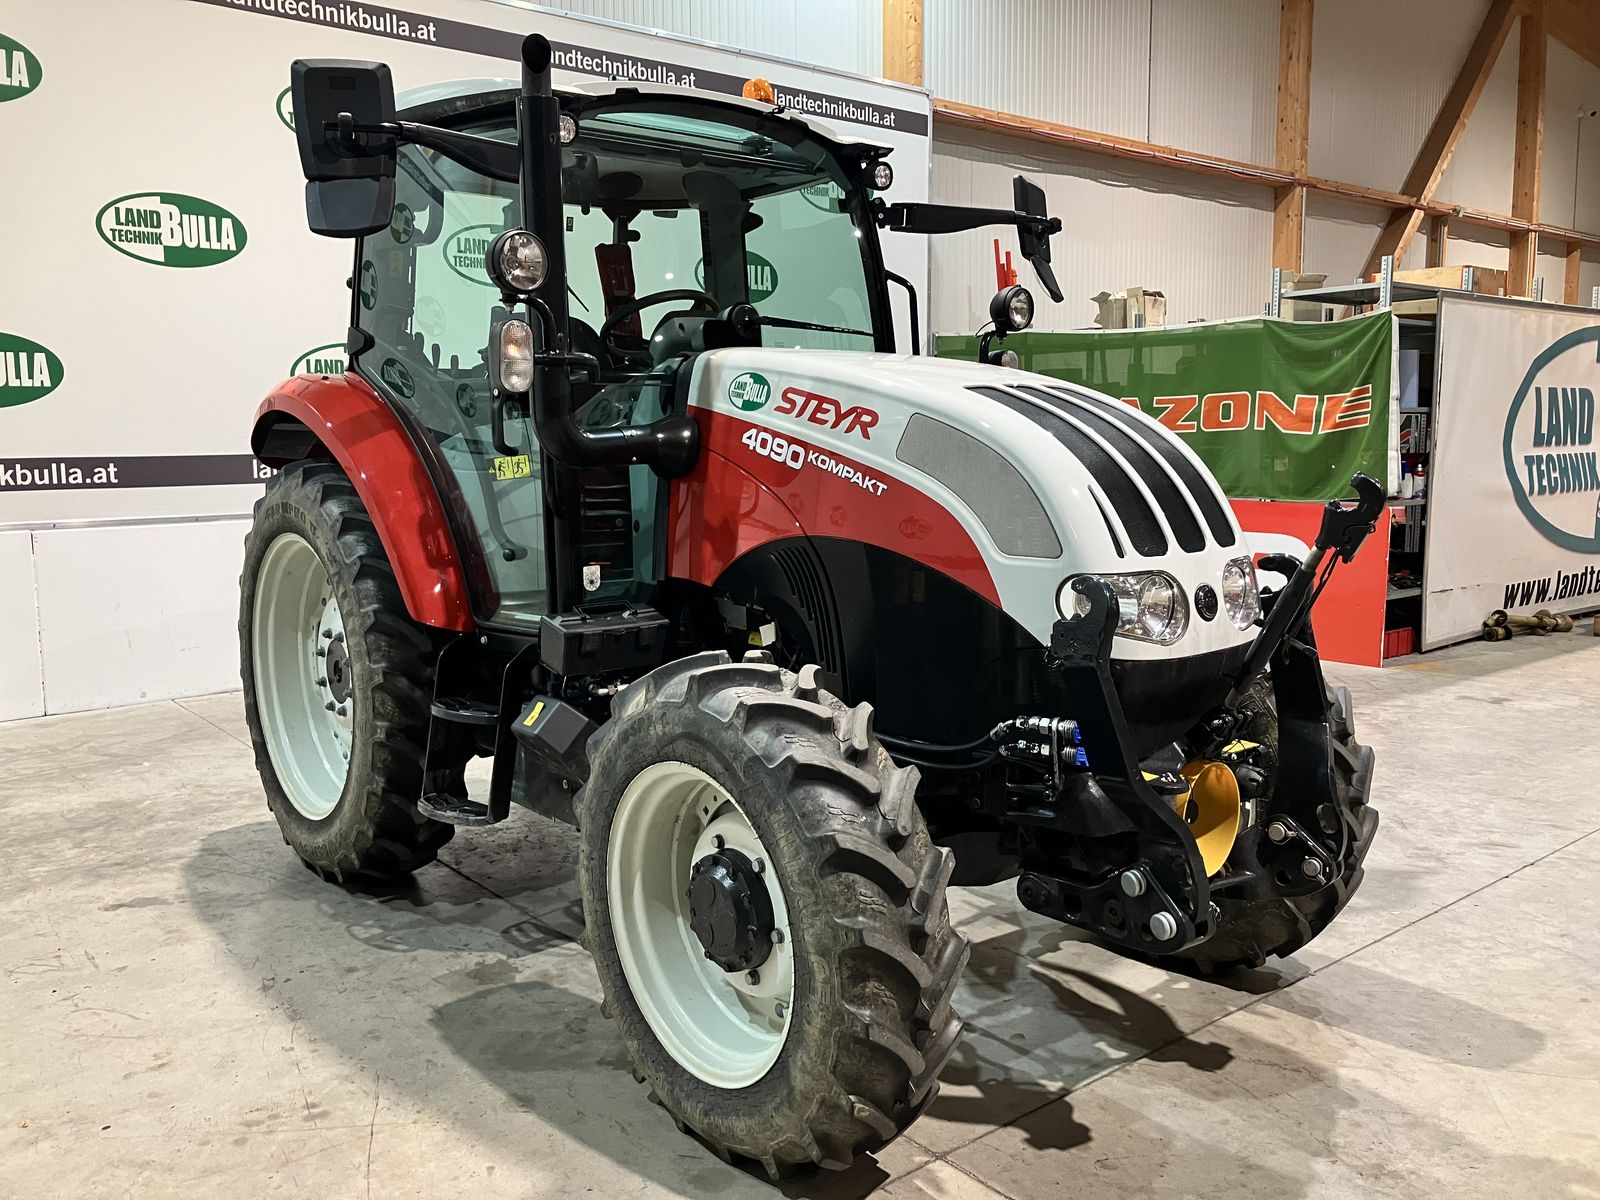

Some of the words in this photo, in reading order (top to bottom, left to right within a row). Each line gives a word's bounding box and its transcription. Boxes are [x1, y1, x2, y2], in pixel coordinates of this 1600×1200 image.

[774, 88, 896, 127] landtechnikbulla.at
[114, 206, 162, 229] LAND
[160, 203, 237, 251] BULLA
[109, 228, 163, 245] TECHNIK
[305, 358, 345, 375] LAND
[733, 380, 748, 392] LAND
[743, 377, 769, 404] BULLA
[773, 386, 880, 441] STEYR
[1532, 386, 1596, 448] LAND
[0, 462, 118, 486] kbulla.at
[741, 428, 806, 470] 4090
[807, 449, 888, 497] KOMPAKT
[1524, 451, 1600, 497] TECHNIK
